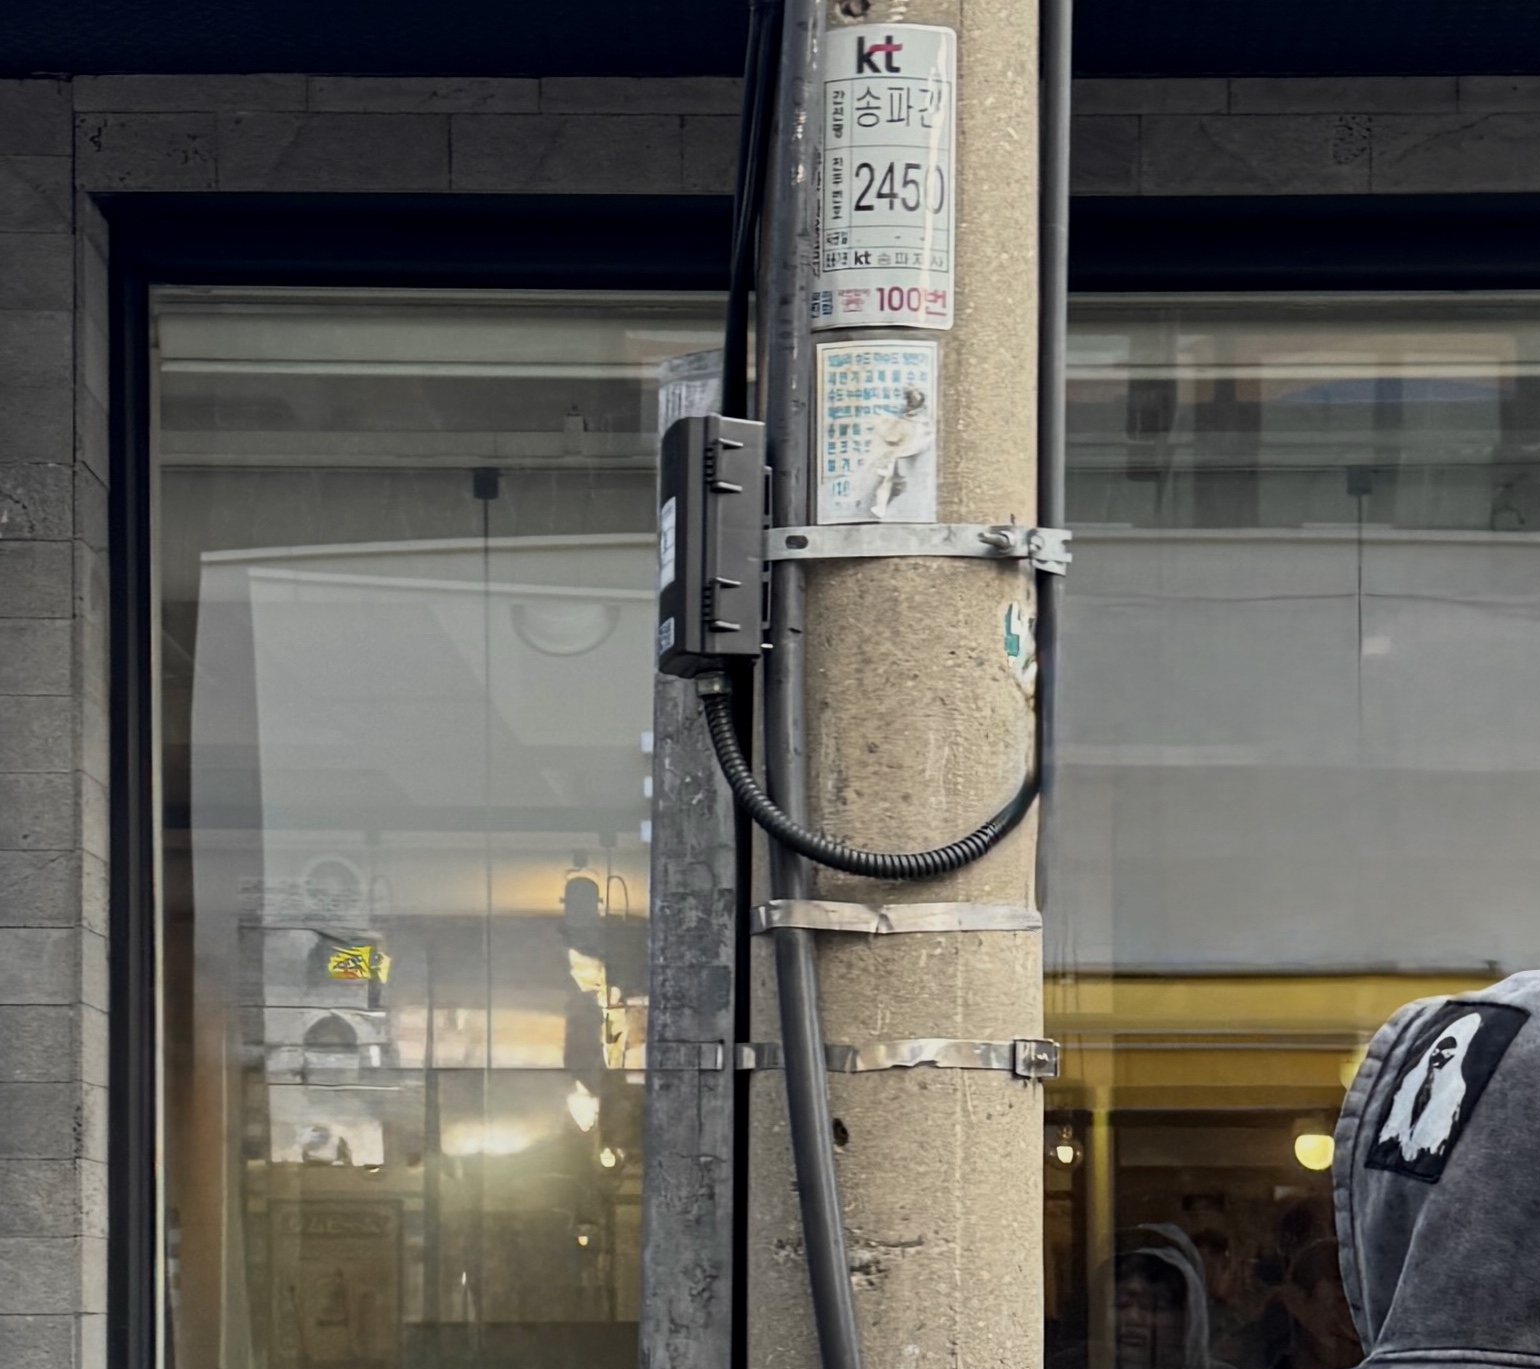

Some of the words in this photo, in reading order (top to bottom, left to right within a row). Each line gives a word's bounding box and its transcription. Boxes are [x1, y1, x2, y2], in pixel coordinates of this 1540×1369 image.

[855, 36, 902, 74] kt
[854, 162, 944, 214] 2450
[854, 251, 872, 265] kt
